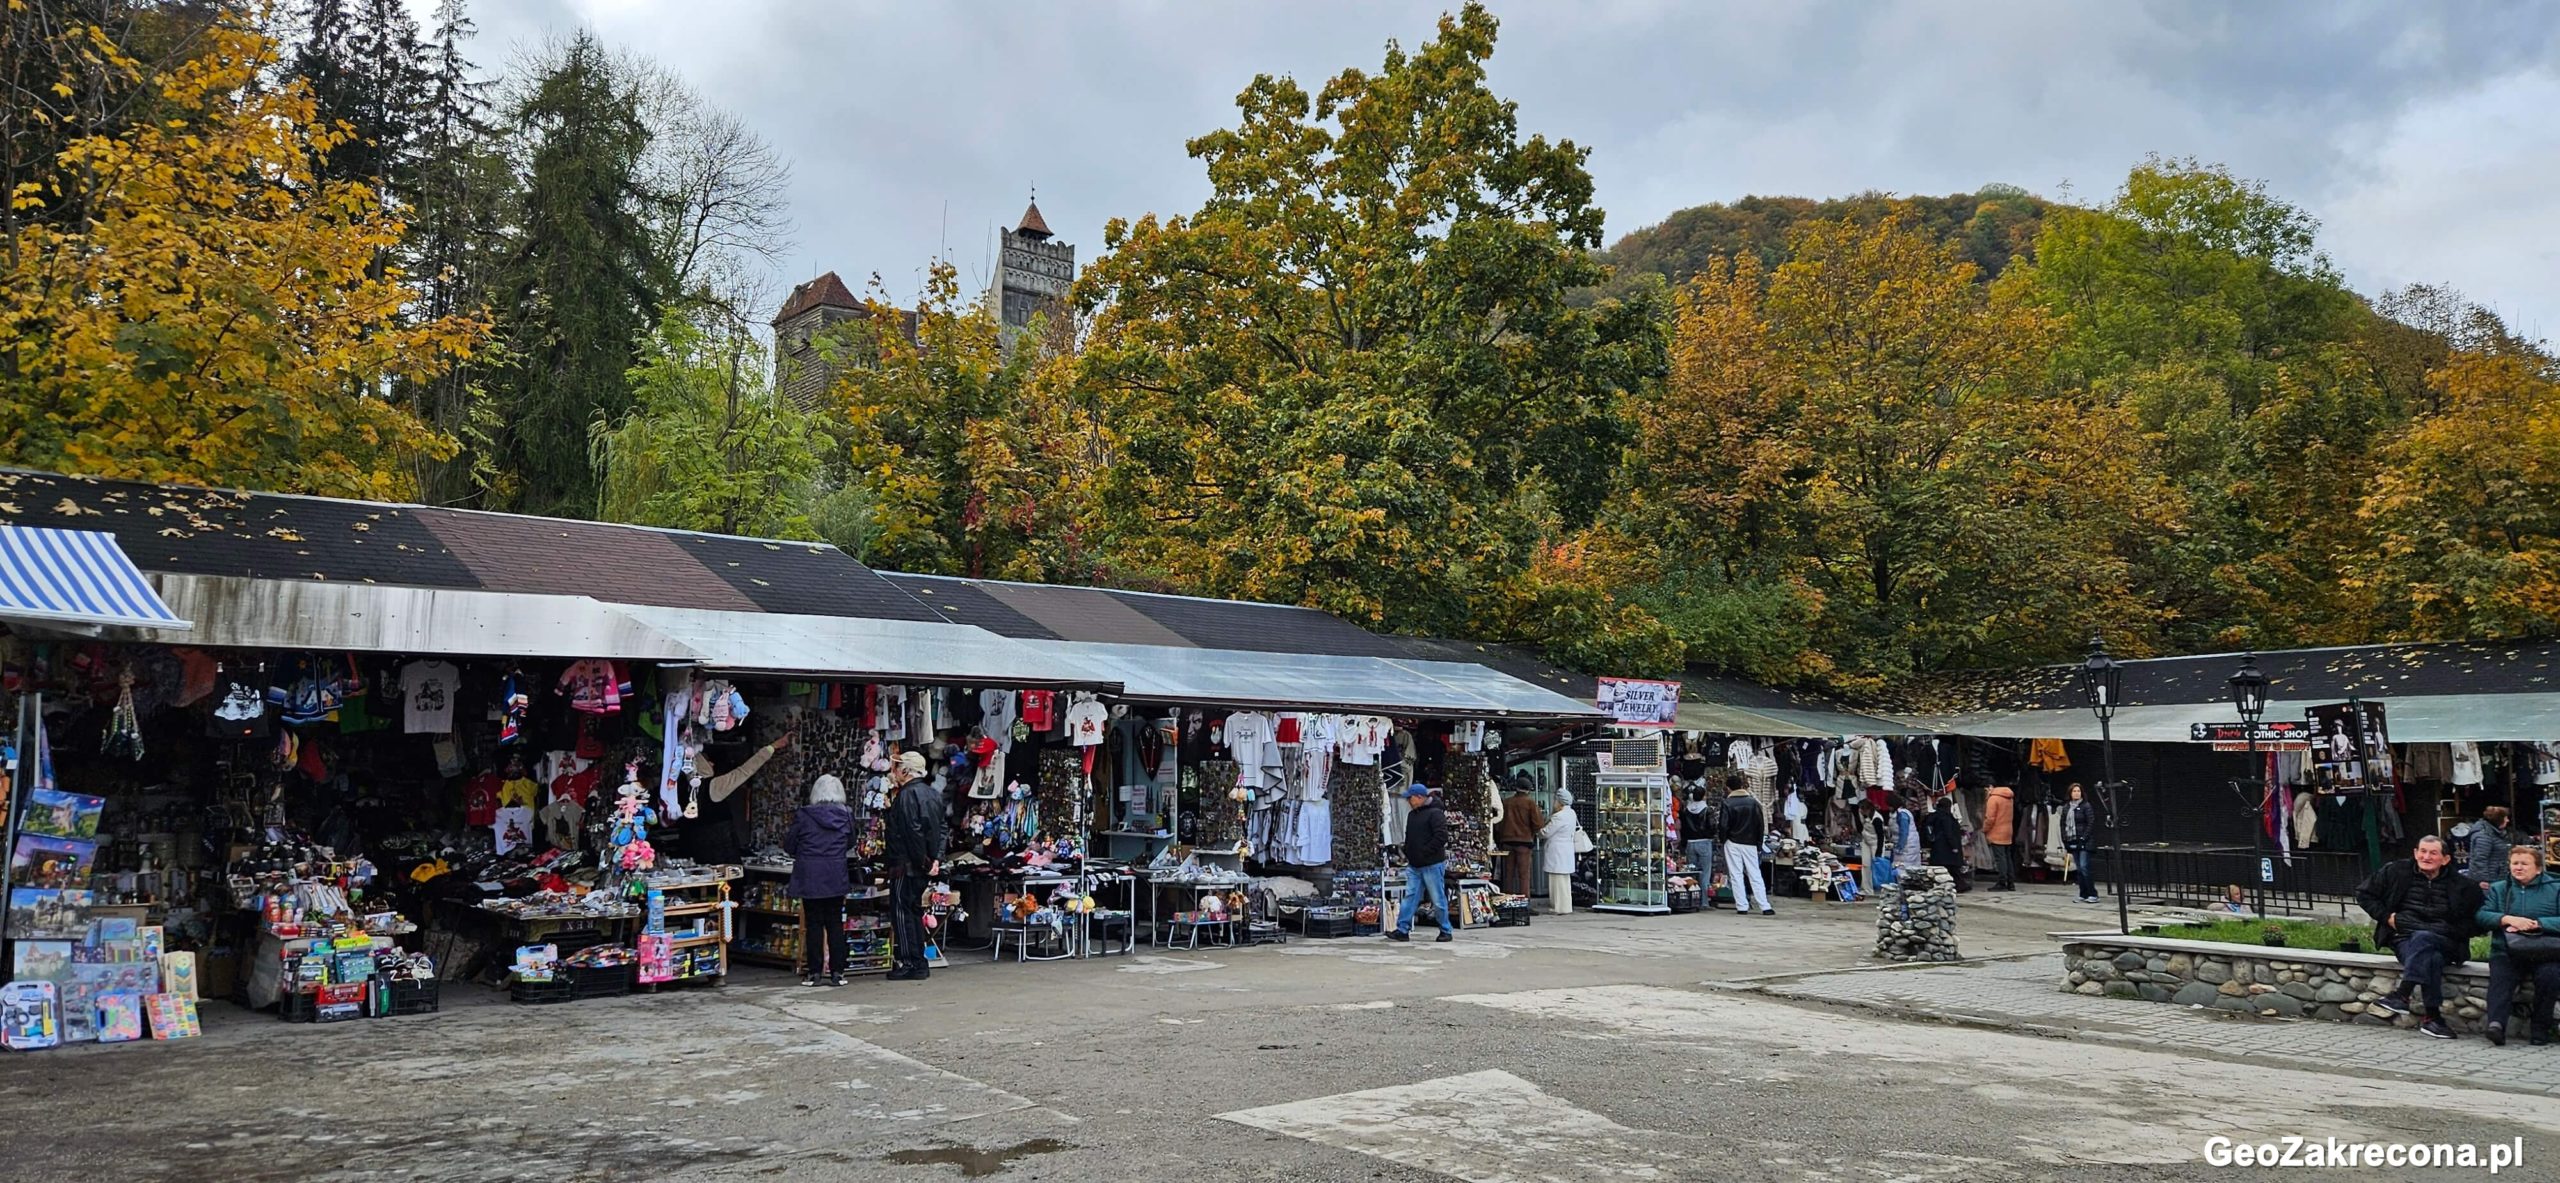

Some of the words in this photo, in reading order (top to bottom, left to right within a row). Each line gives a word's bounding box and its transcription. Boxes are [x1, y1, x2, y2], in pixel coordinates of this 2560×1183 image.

[1624, 690, 1655, 701] SILVER
[1618, 702, 1658, 713] JEWELRY
[2284, 729, 2309, 738] SHOP
